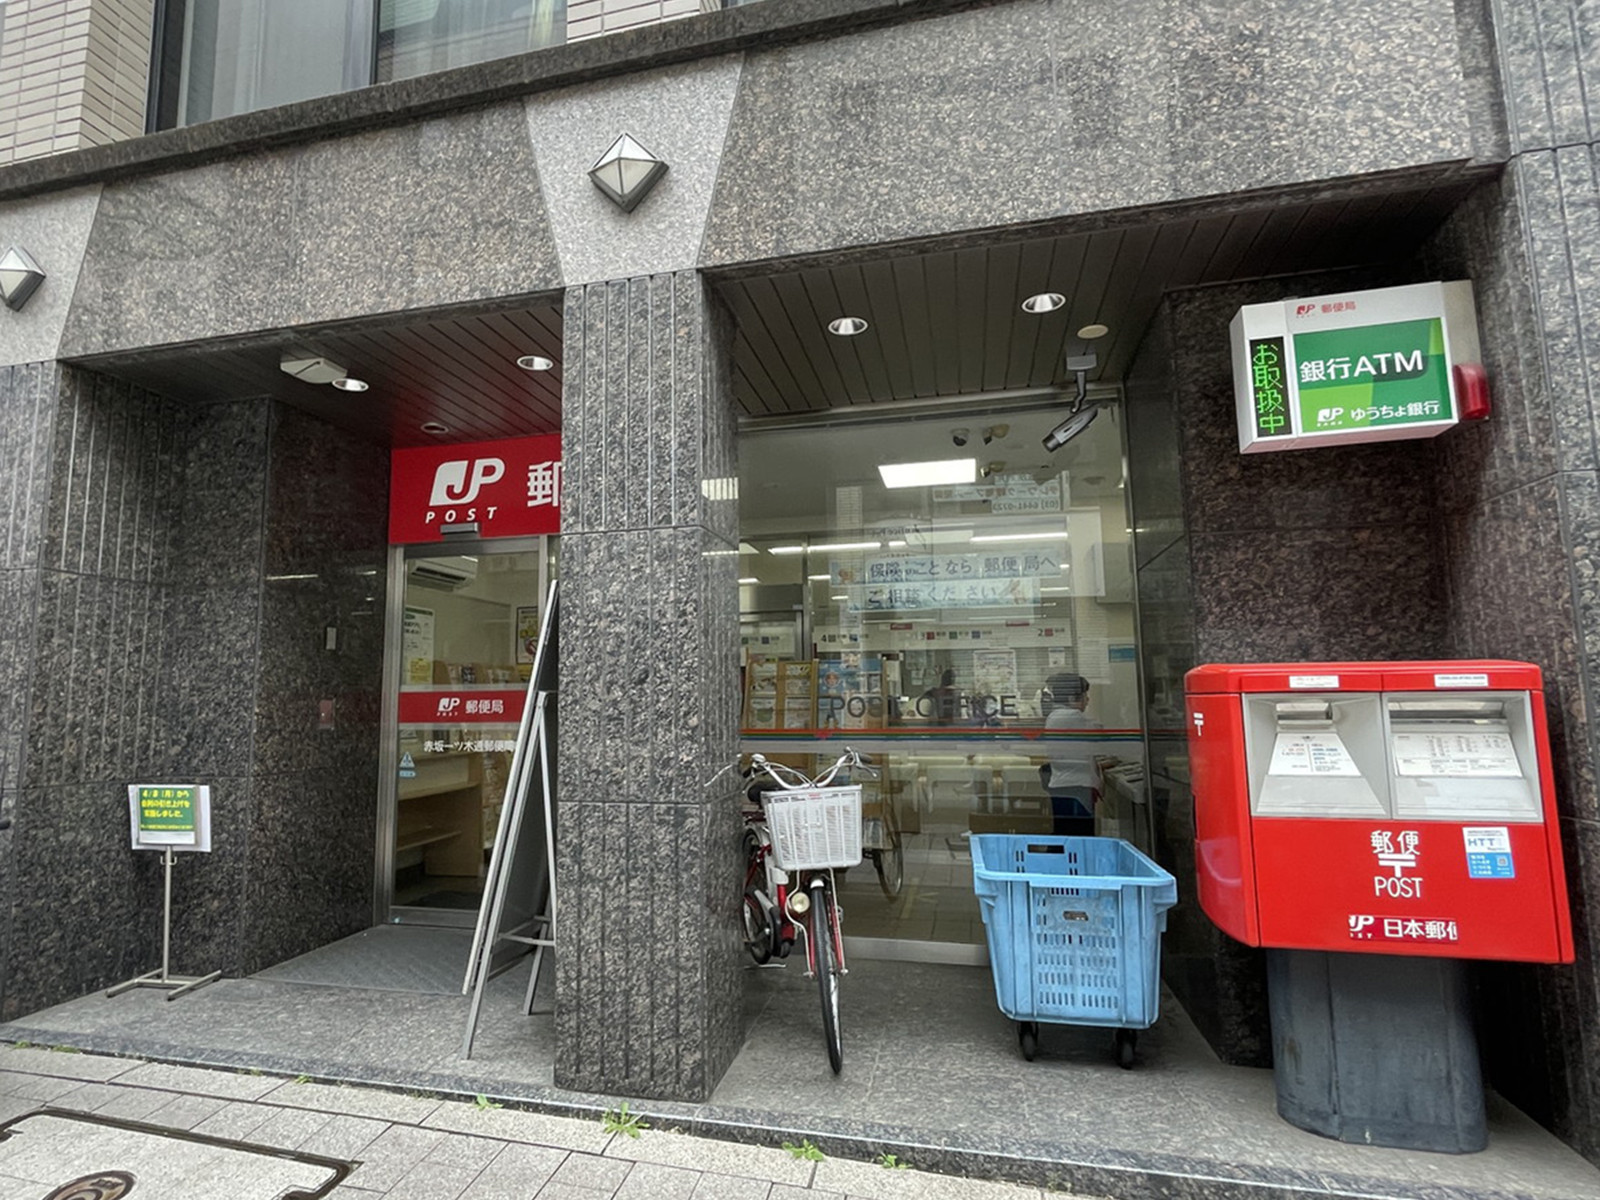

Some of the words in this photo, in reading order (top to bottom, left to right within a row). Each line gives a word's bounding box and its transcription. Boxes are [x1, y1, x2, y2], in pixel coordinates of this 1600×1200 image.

[1300, 349, 1424, 383] 銀行ATM
[1253, 344, 1284, 434] お取扱中
[1350, 400, 1440, 422] ゆうちょ銀行
[425, 506, 498, 524] POST
[465, 699, 504, 714] 郵便局
[1370, 830, 1421, 855] 郵便
[1467, 837, 1496, 847] HTT
[1374, 876, 1424, 898] POST
